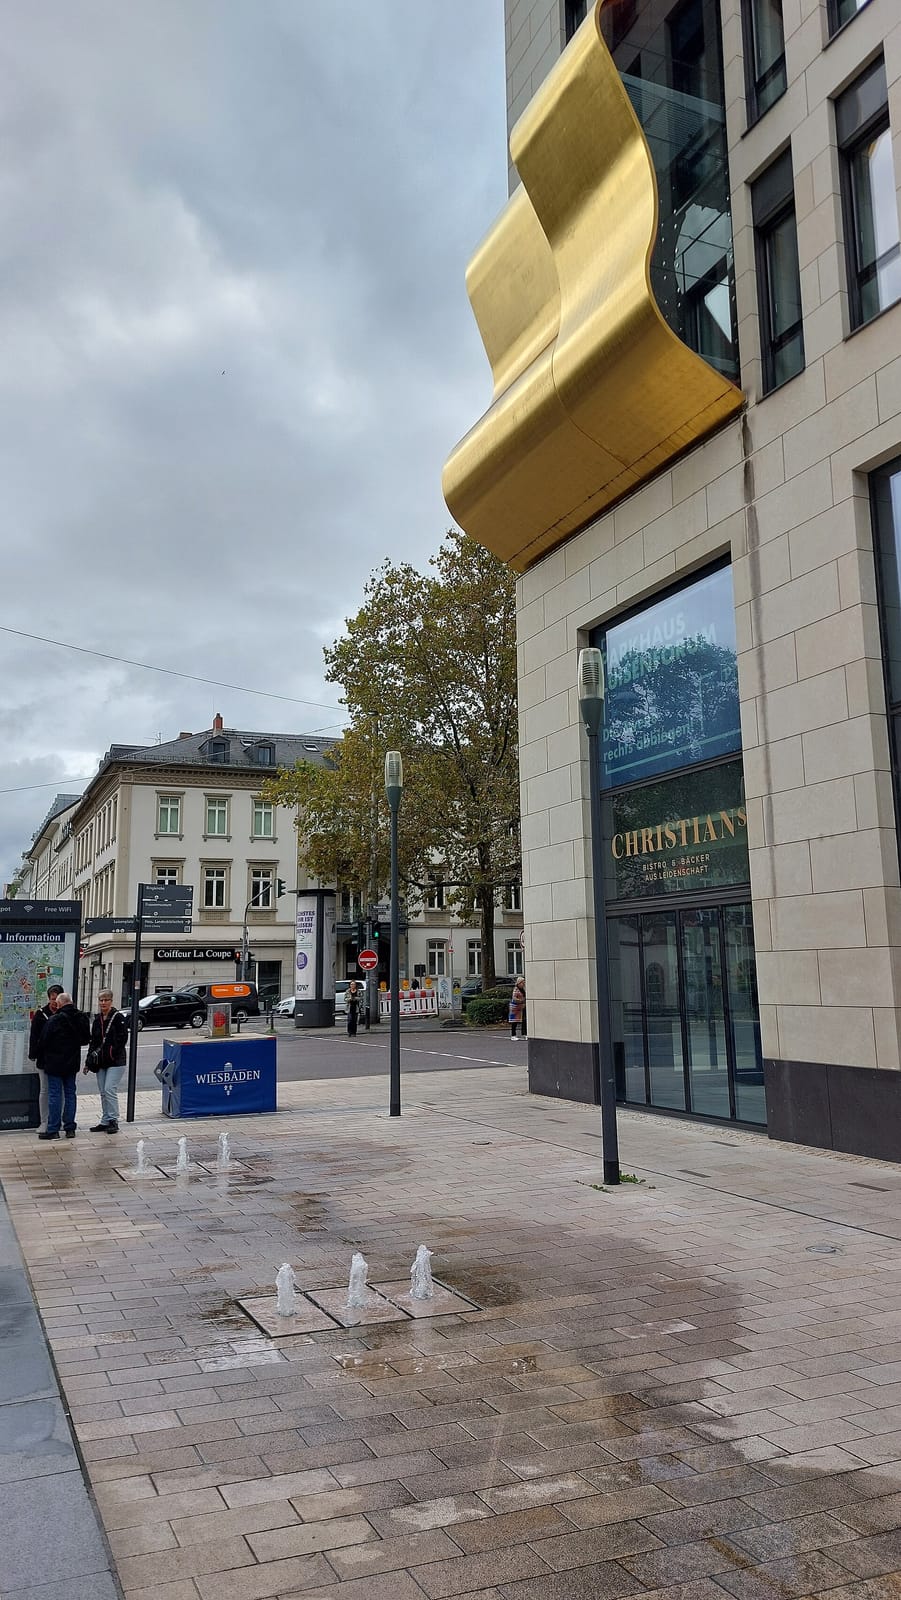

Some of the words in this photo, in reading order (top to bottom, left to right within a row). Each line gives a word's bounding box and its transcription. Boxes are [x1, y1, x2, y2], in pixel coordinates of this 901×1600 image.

[603, 740, 634, 762] rechts
[611, 806, 747, 859] CHRISTIANS
[642, 860, 667, 872] BISTRO
[681, 853, 711, 866] BÄCKER
[645, 871, 658, 881] AUS
[659, 864, 709, 879] LEIDENSCHAFT
[6, 932, 61, 942] Information
[157, 949, 192, 958] Coiffeur
[193, 949, 204, 958] La
[205, 949, 232, 960] Coupe
[195, 1070, 261, 1084] WIESBADEN
